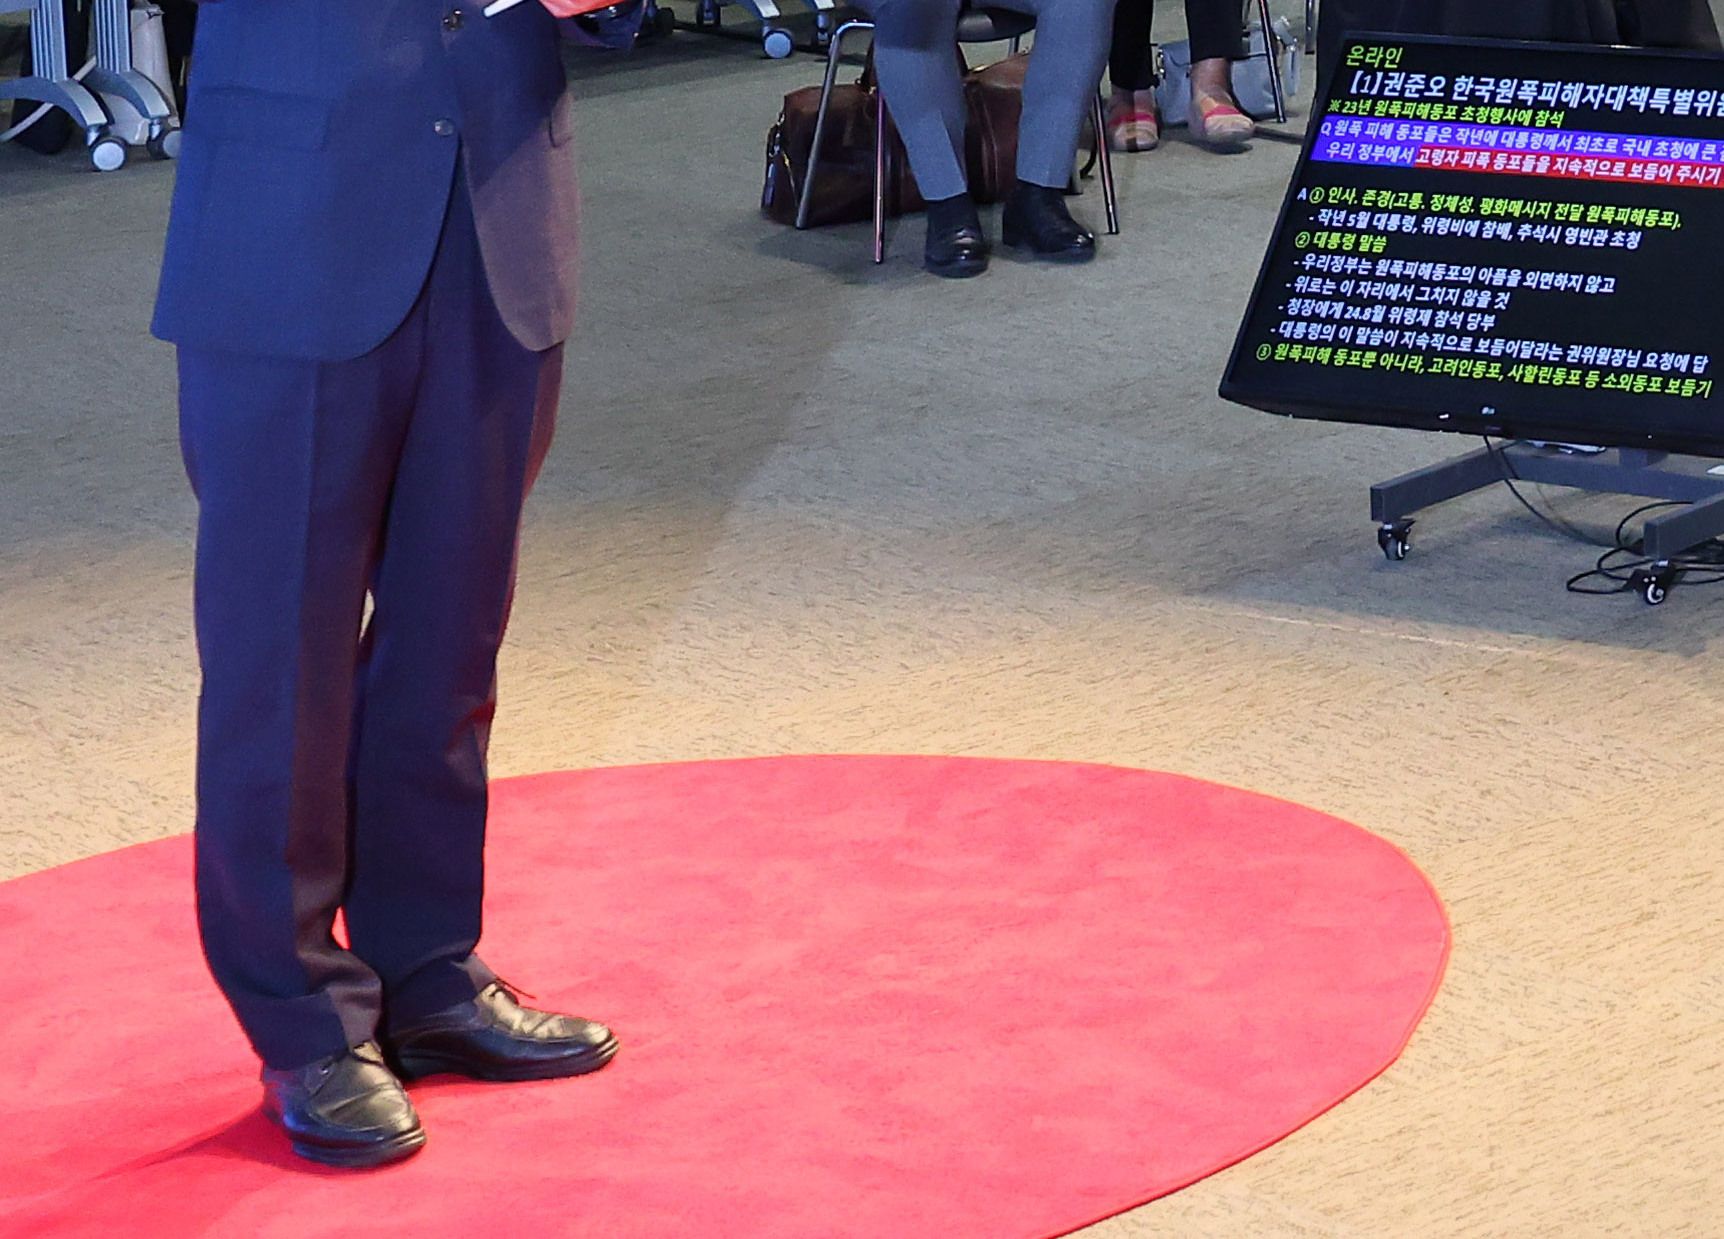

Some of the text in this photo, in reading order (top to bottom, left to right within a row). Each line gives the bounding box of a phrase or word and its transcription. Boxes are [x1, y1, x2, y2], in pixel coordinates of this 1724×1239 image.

[1346, 45, 1403, 69] 온라인
[1341, 99, 1373, 116] 23년
[1373, 100, 1459, 121] 원폭피해동포
[1459, 105, 1534, 126] 초청행사에
[1534, 109, 1565, 128] 참석
[1320, 122, 1332, 136] Q
[1334, 119, 1363, 138] 원폭
[1364, 121, 1395, 140] 피해
[1396, 123, 1453, 144] 동포들은
[1455, 127, 1500, 147] 작년에
[1500, 130, 1574, 152] 대통령께서
[1573, 135, 1619, 154] 최초로
[1622, 138, 1653, 158] 국내
[1652, 140, 1700, 160] 초청에
[1701, 143, 1717, 161] 큰
[1326, 141, 1356, 160] 우리
[1357, 143, 1415, 164] 정부에서
[1414, 148, 1460, 168] 고령자
[1460, 150, 1491, 170] 피폭
[1493, 152, 1551, 174] 동포들을
[1552, 157, 1626, 177] 지속적으로
[1627, 162, 1675, 182] 보듬어
[1676, 165, 1722, 185] 주시기
[1297, 187, 1307, 201] A
[1479, 197, 1553, 220] 평화메시지
[1554, 203, 1585, 222] 전달
[1312, 231, 1357, 251] 대통령
[1358, 234, 1387, 253] 말씀
[1317, 208, 1347, 227] 작년
[1346, 211, 1372, 229] 5월
[1421, 216, 1481, 238] 위령비에
[1516, 223, 1562, 244] 추석시
[1564, 226, 1609, 247] 영빈관
[1609, 230, 1642, 250] 초청
[1301, 252, 1616, 294] 우리정부는 원폭피해동포의 아픔을 외면하지 않고
[1294, 275, 1511, 310] 위로는 이 자리에서 그치지 않을 것
[1287, 297, 1496, 332] 청장에게 24.8월 위령제 참석 당부
[1278, 320, 1709, 374] 대통령의 이 말씀이 지속적으로 보듬어달라는 권위원장님 요청에 답
[1274, 343, 1333, 365] 원폭피해
[1333, 348, 1378, 369] 동포뿐
[1507, 363, 1583, 386] 사할린동포
[1584, 370, 1601, 389] 등
[1601, 372, 1664, 393] 소외동포
[1664, 378, 1713, 399] 보듬기
